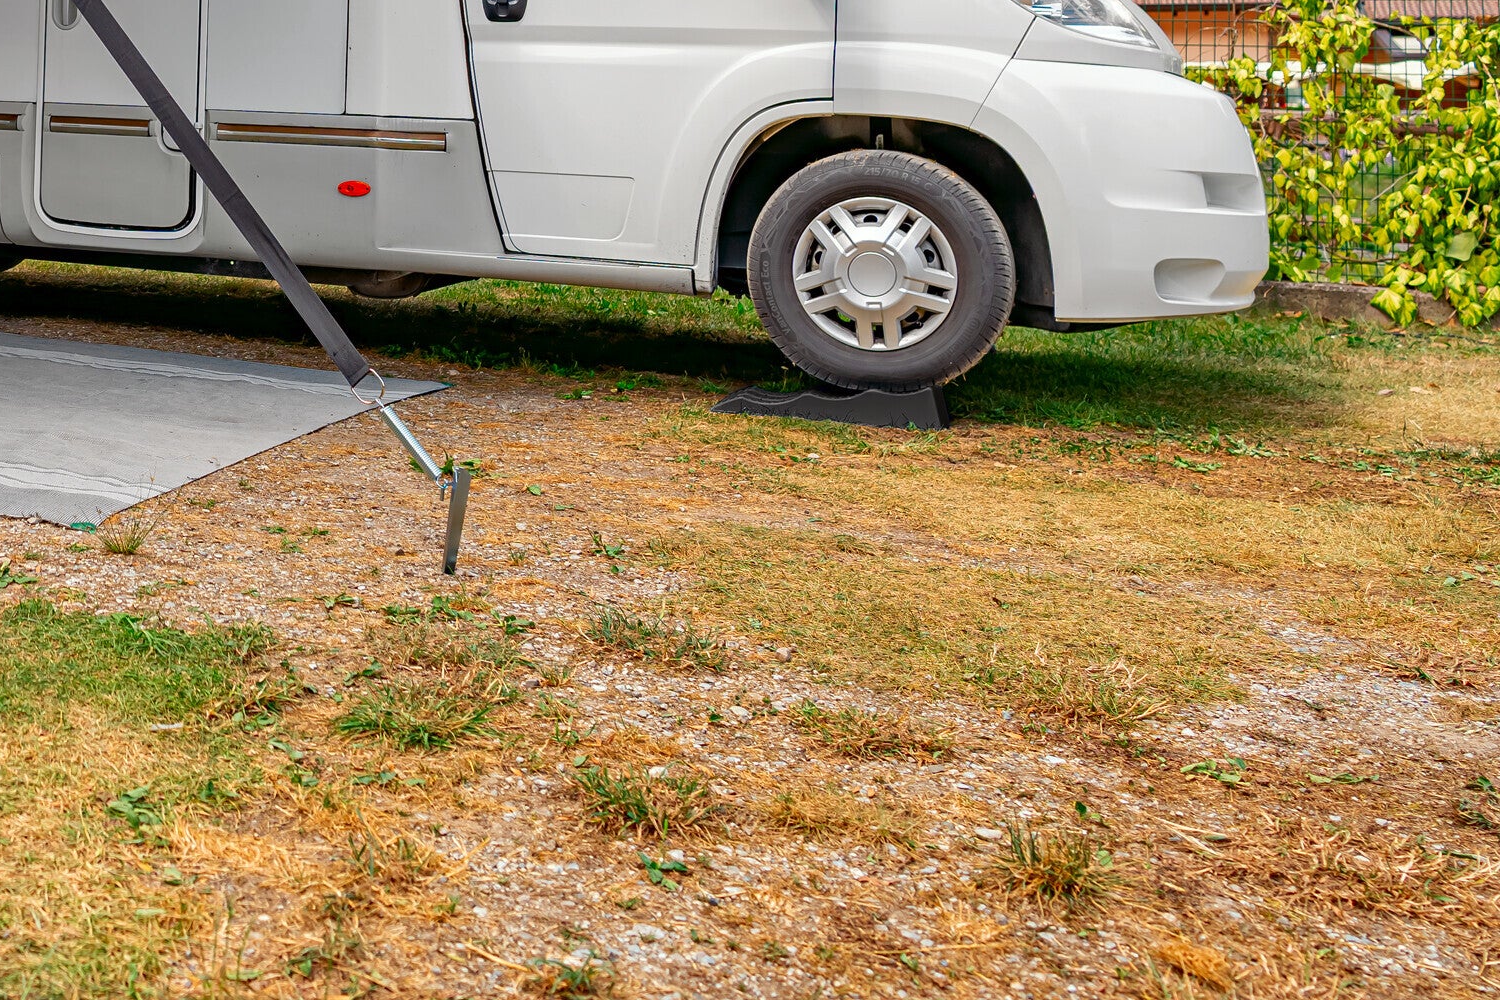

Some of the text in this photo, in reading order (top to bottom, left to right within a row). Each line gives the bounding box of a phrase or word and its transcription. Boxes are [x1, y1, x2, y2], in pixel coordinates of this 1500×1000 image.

[864, 167, 899, 178] 215/70
[902, 172, 909, 181] R
[761, 260, 792, 335] VanContact Eco
